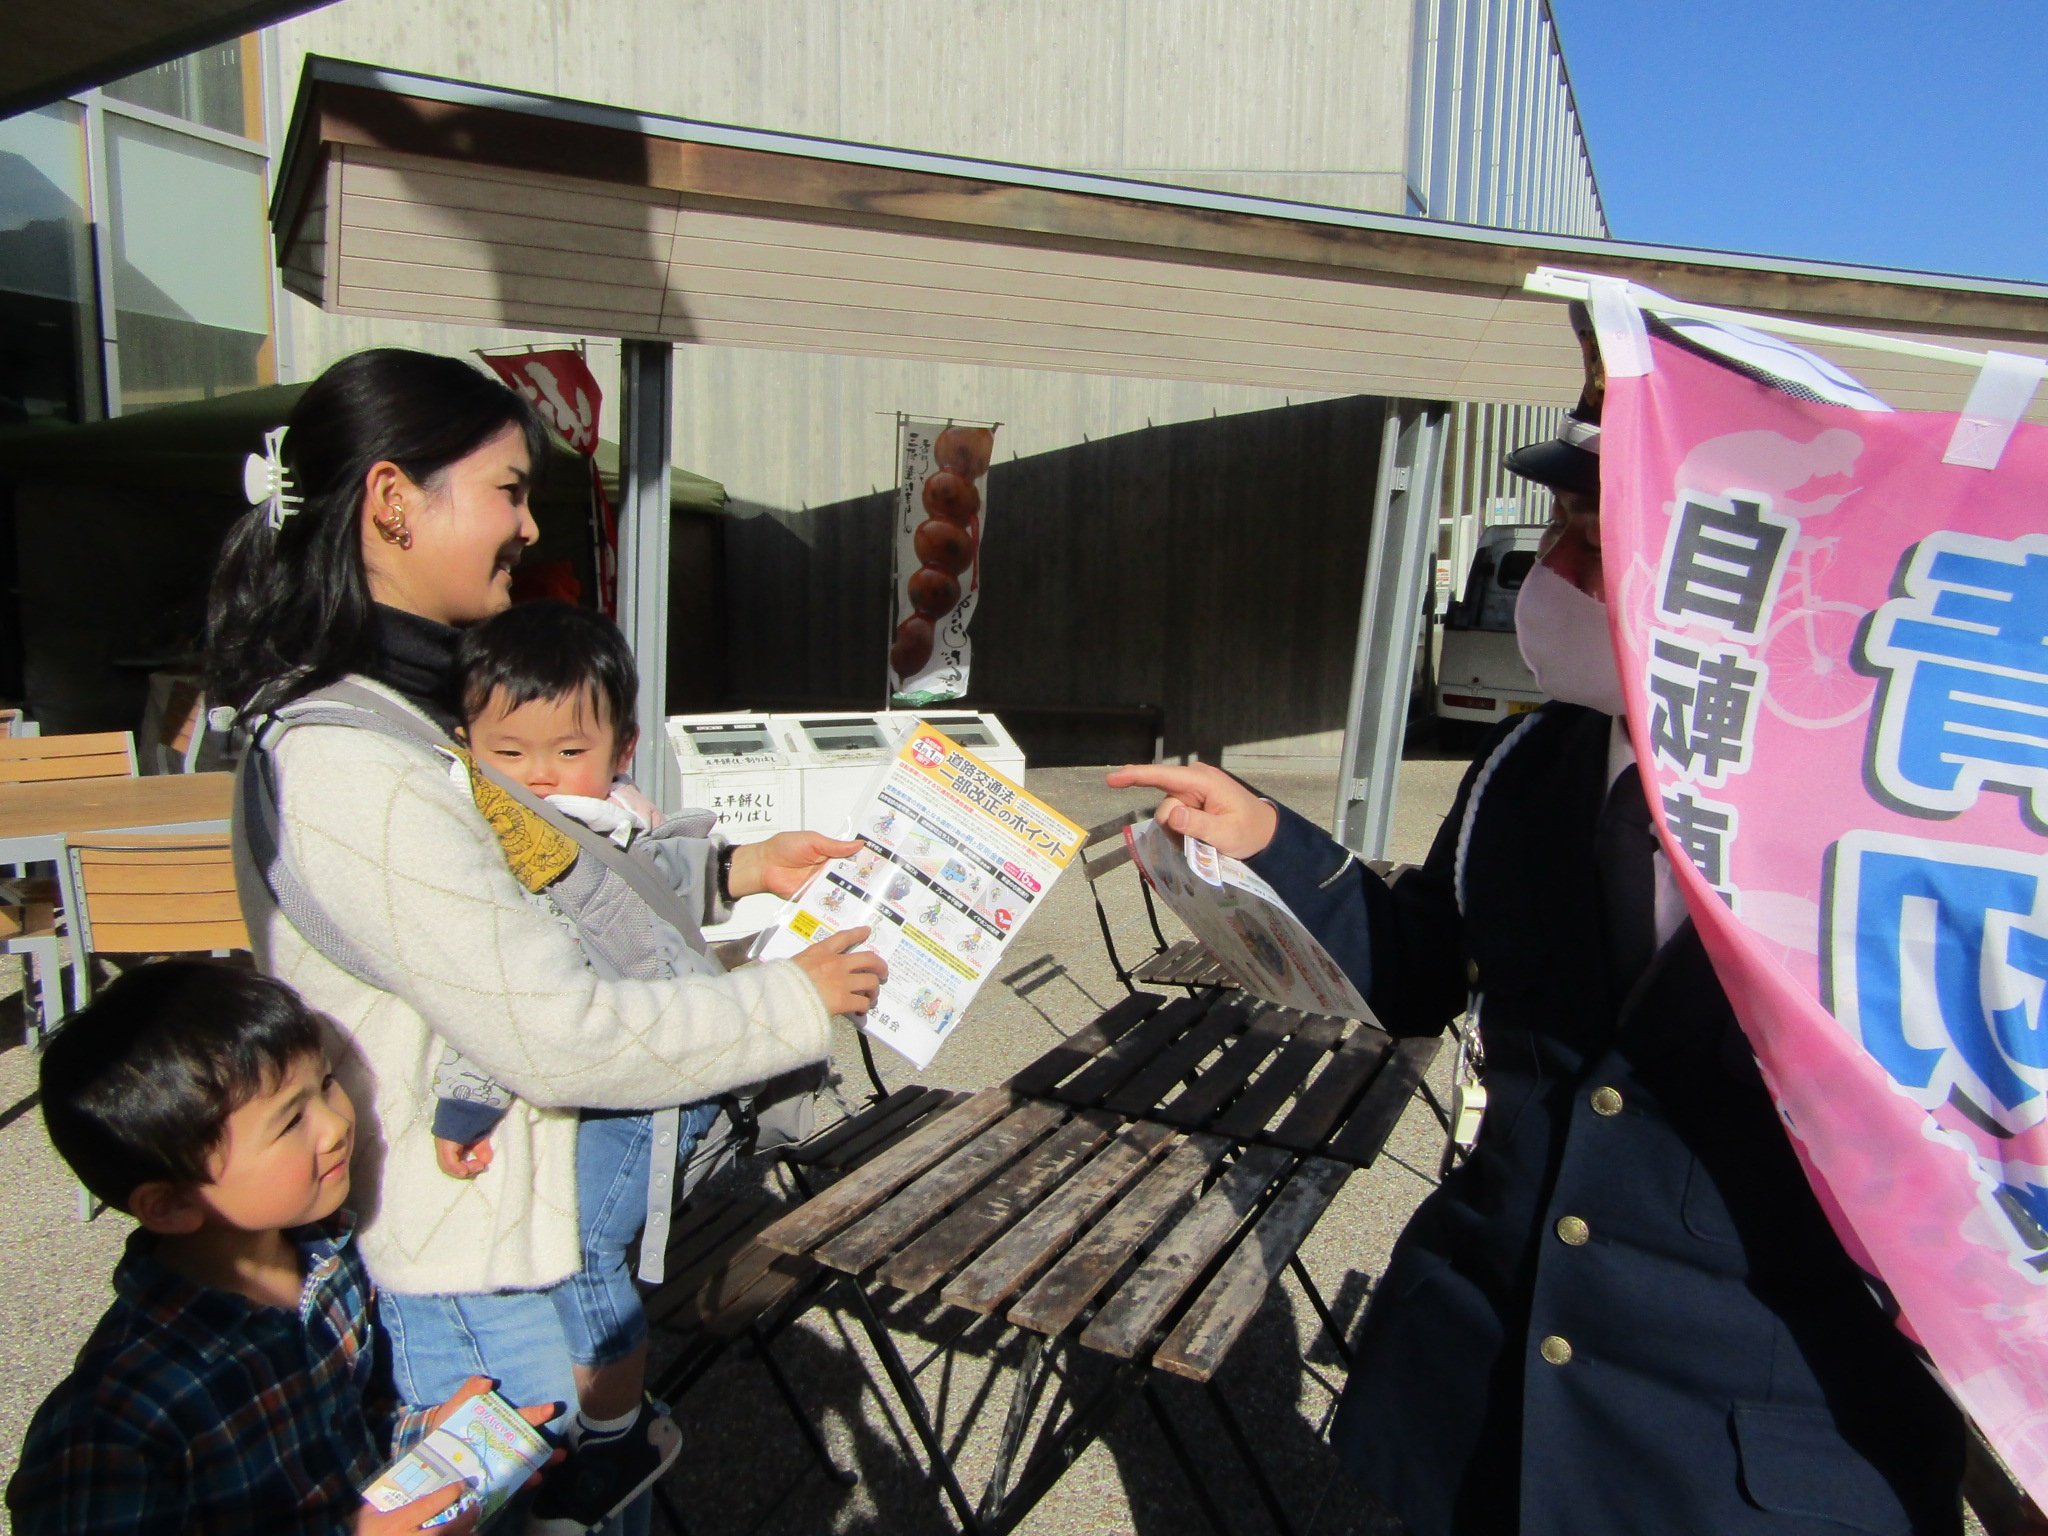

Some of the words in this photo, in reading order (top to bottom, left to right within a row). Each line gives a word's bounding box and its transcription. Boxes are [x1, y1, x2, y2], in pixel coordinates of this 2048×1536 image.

[913, 739, 943, 763] 4月1日
[945, 751, 1017, 804] 道路交通法
[712, 794, 775, 807] 五平餅くし
[934, 764, 1070, 861] 一部改正のポイント
[718, 810, 773, 823] わりばし
